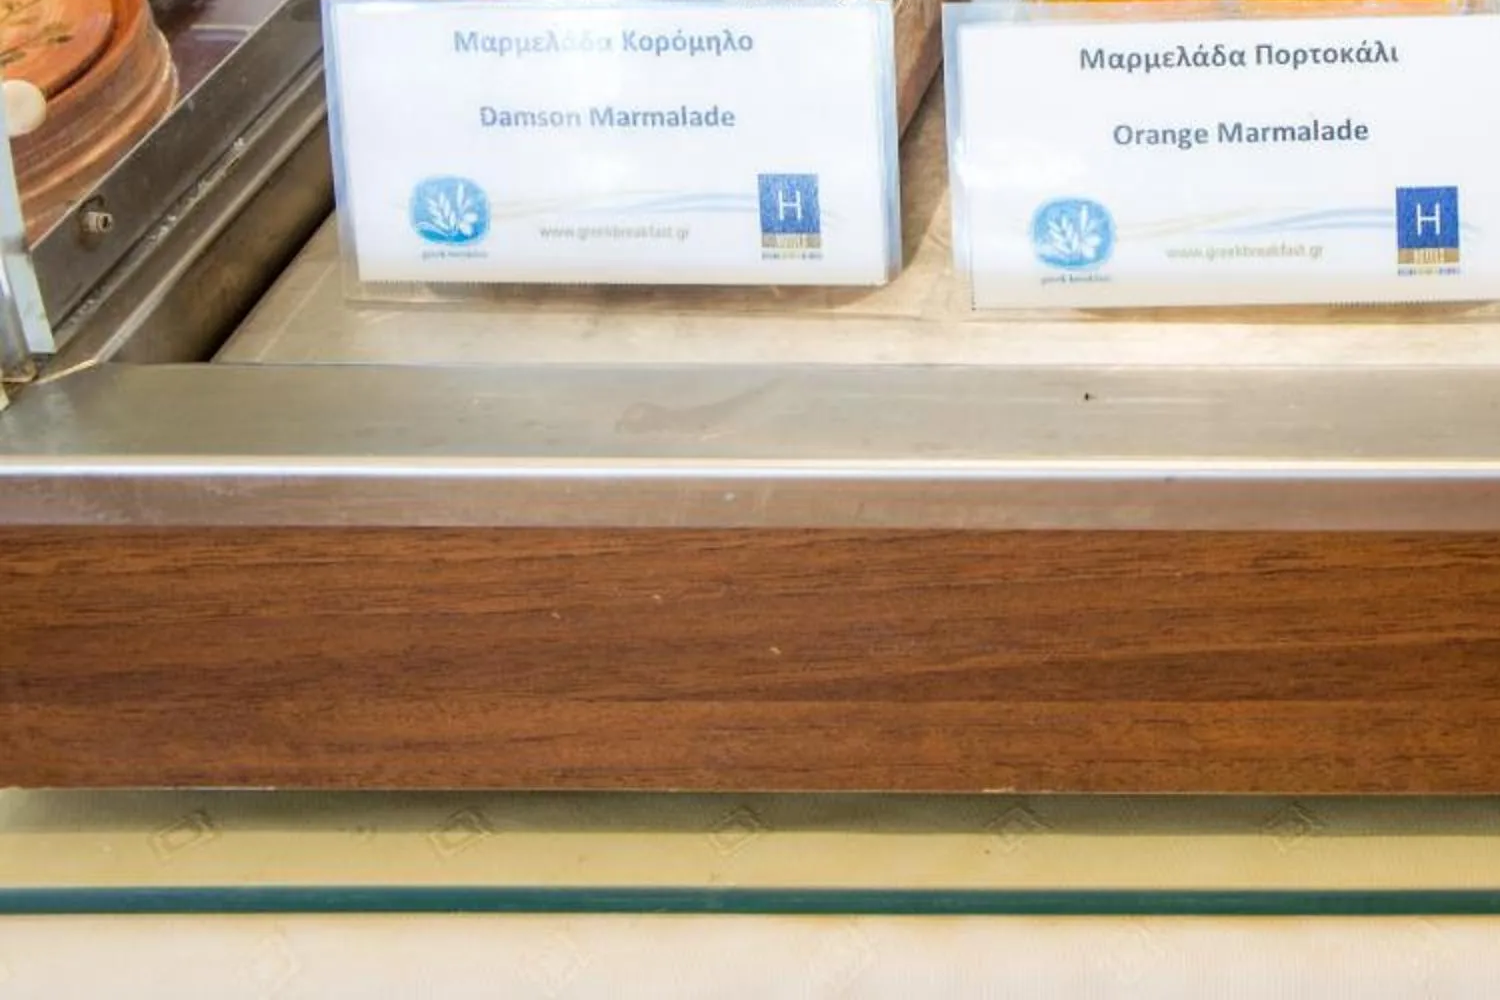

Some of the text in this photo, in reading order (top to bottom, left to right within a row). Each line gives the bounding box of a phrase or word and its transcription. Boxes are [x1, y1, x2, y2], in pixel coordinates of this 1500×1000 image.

[622, 28, 754, 57] Κορόμηλο
[1079, 39, 1400, 74] Μαρμελάδα Πορτοκάλι
[479, 105, 736, 128] Damson Marmalade
[1112, 118, 1370, 149] Orange Marmalade
